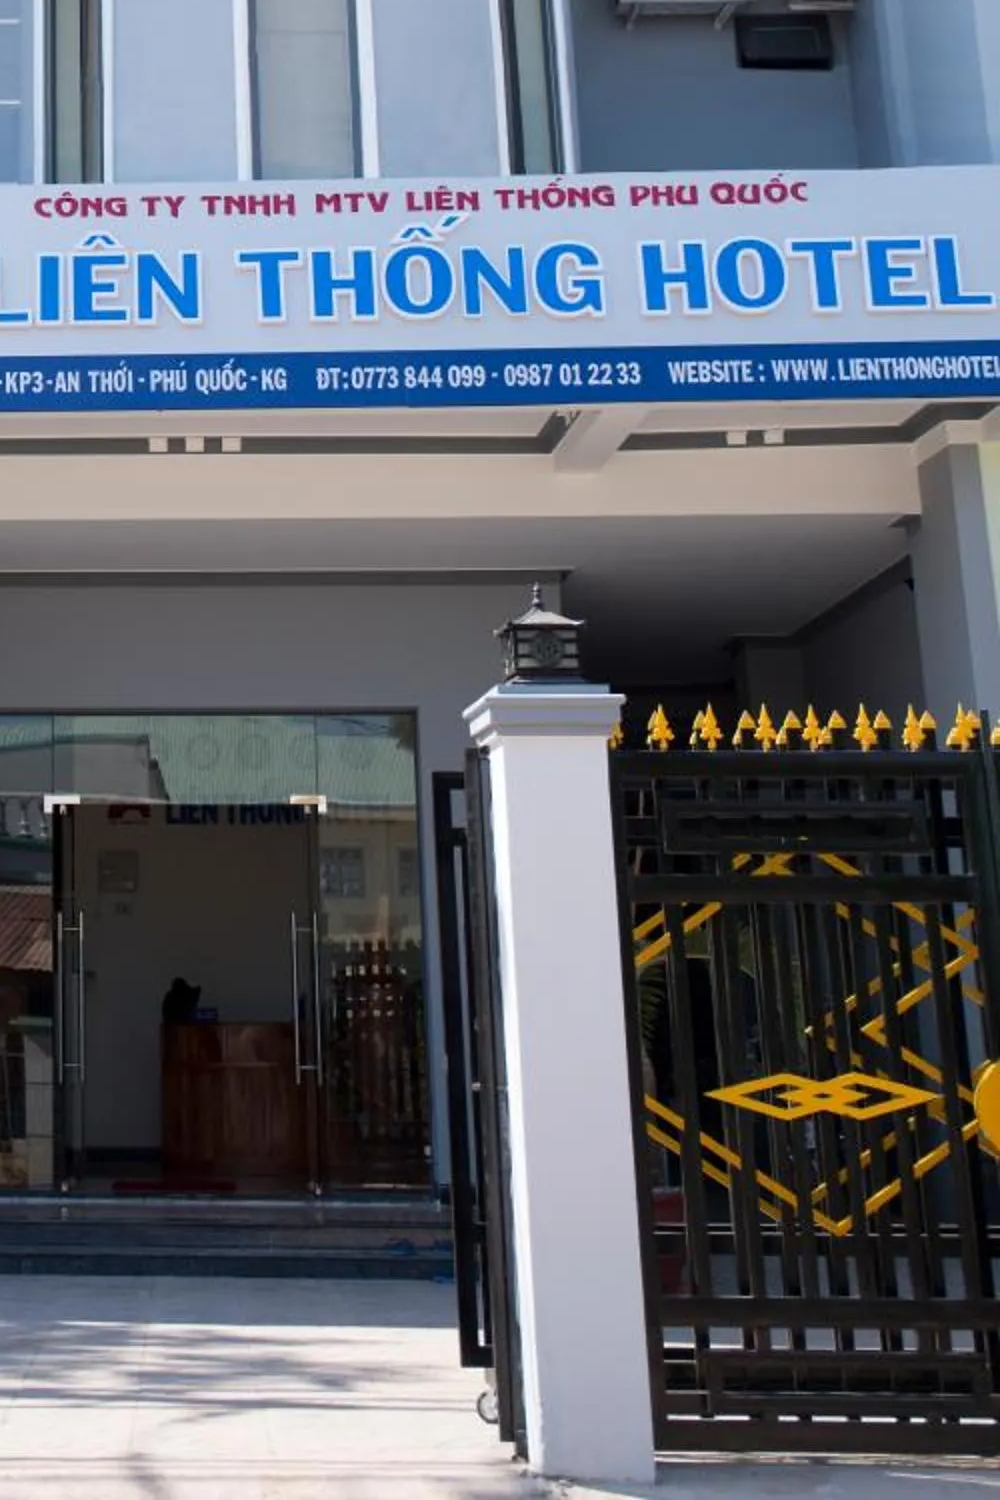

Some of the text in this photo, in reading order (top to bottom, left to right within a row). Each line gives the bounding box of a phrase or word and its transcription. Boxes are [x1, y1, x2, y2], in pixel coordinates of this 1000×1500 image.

[33, 192, 129, 219] CÔNG
[141, 196, 186, 219] TY
[202, 194, 297, 218] TNHH
[314, 192, 390, 214] MTV
[405, 185, 481, 213] LIÊN
[494, 177, 616, 212] THỐNG
[708, 173, 809, 206] QUỐC
[237, 214, 604, 319] THỐNG
[639, 236, 994, 312] HOTEL
[404, 366, 443, 388] 844
[447, 365, 486, 388] 099
[503, 364, 552, 387] 0987
[559, 363, 582, 385] 01
